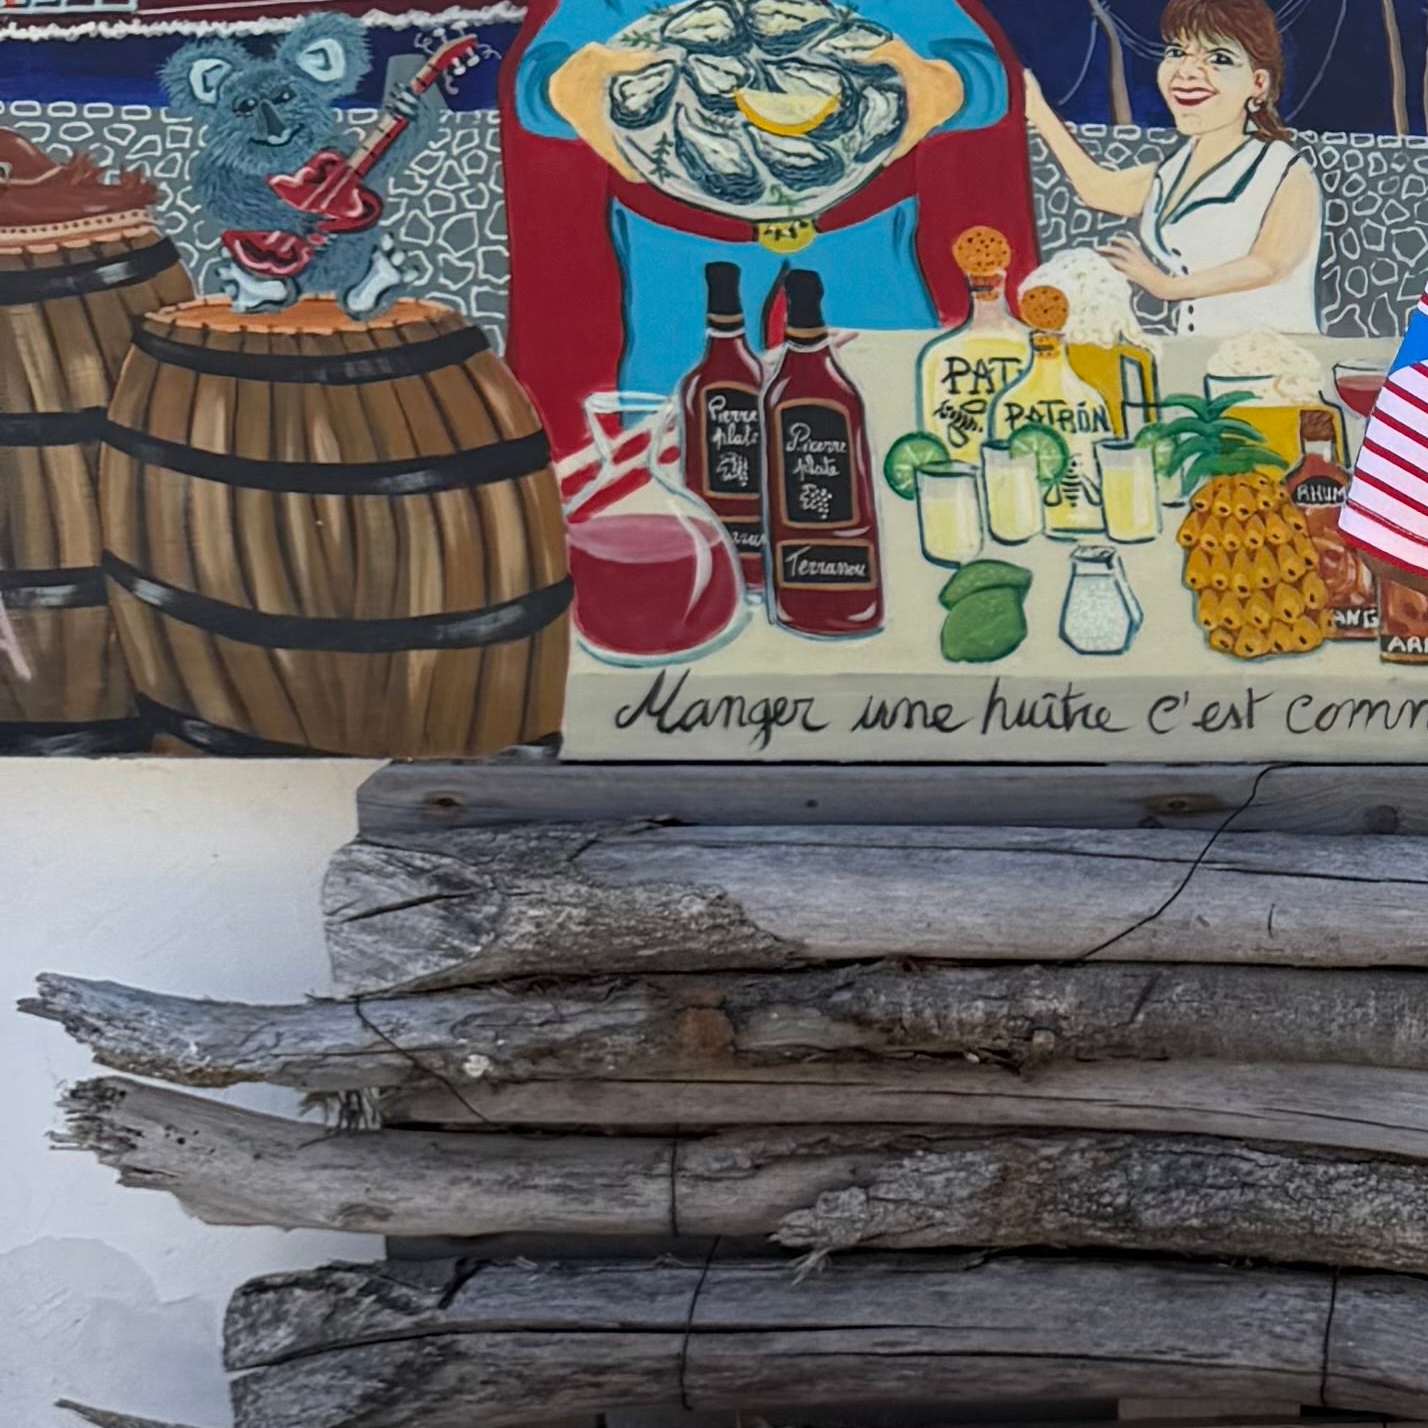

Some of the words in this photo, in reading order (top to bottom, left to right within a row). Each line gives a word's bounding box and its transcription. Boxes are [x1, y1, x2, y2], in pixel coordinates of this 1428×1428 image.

[941, 356, 1024, 395] PAT
[1330, 608, 1379, 629] ANG
[614, 668, 831, 751] Manger
[850, 692, 973, 735] une
[980, 675, 1131, 735] huître
[1147, 686, 1276, 735] c'est
